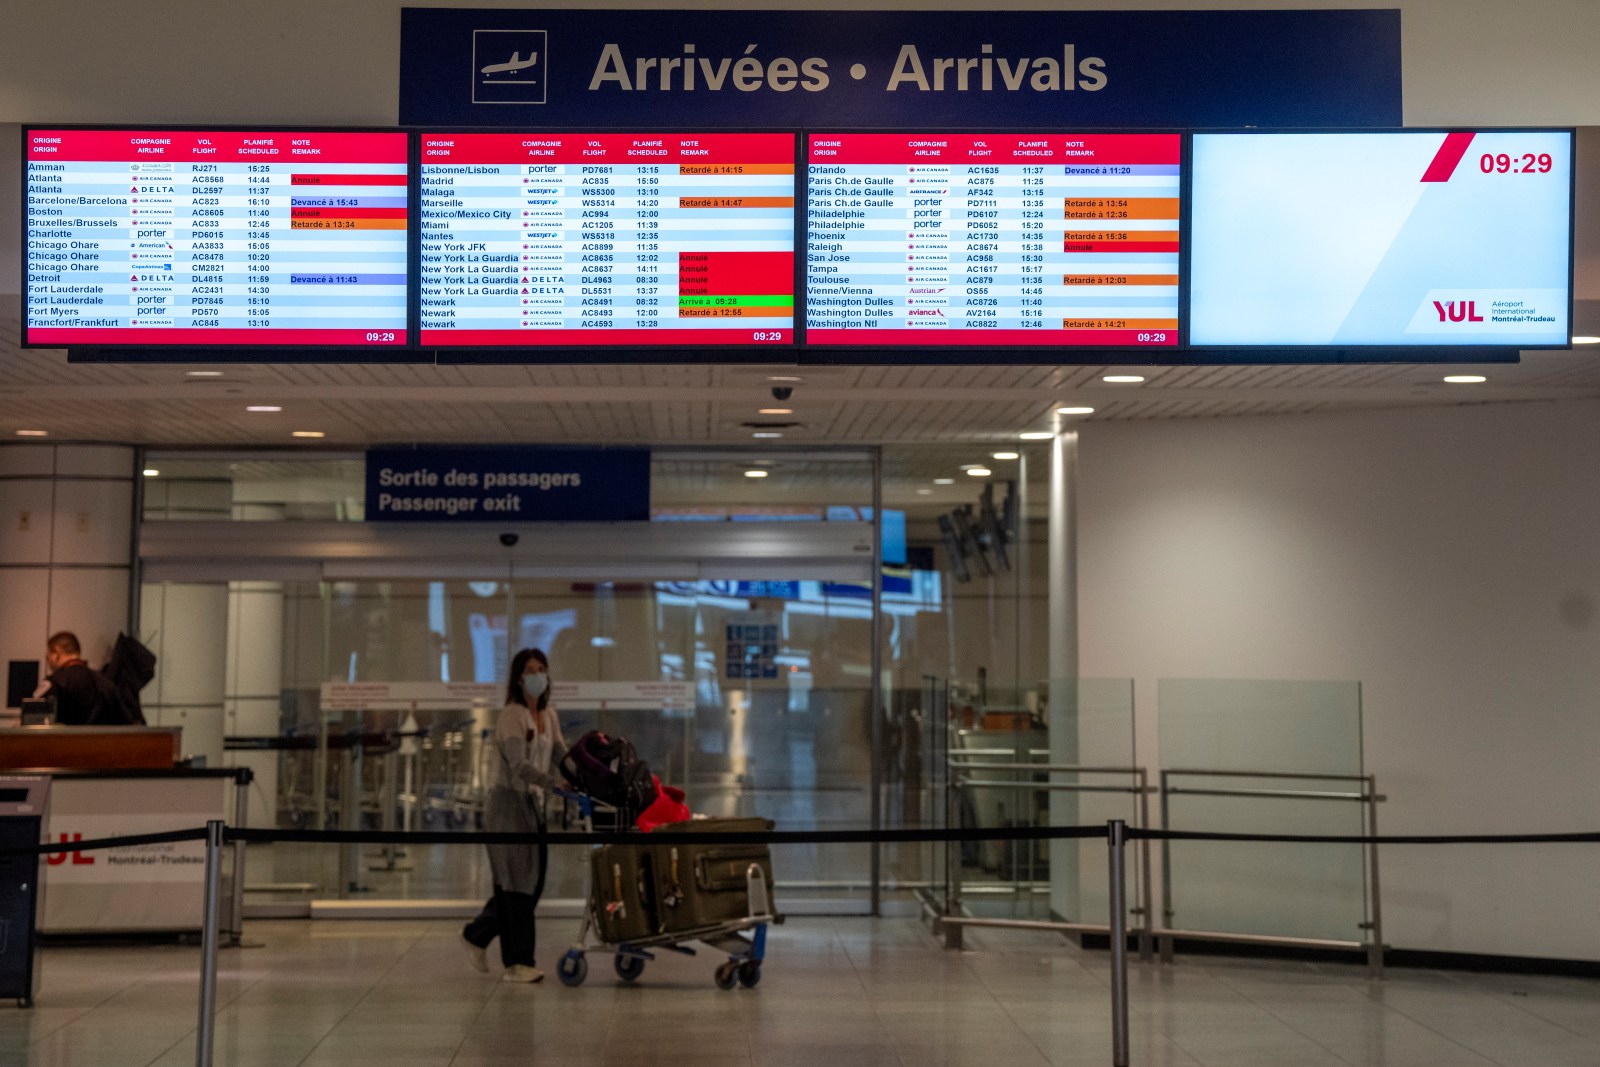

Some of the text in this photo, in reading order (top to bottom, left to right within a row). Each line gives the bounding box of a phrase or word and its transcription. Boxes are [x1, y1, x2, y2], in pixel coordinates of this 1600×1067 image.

[588, 43, 1108, 92] Arrivées Arrivals
[1480, 153, 1552, 173] 09:29
[421, 188, 454, 198] Malaga
[808, 210, 864, 220] Philadelphie
[808, 243, 842, 253] Raleigh
[807, 309, 862, 318] Washington
[1433, 301, 1484, 322] YUL
[366, 333, 394, 341] 09:29
[379, 468, 581, 490] Sortie des passagers
[379, 493, 520, 515] Passenger exit
